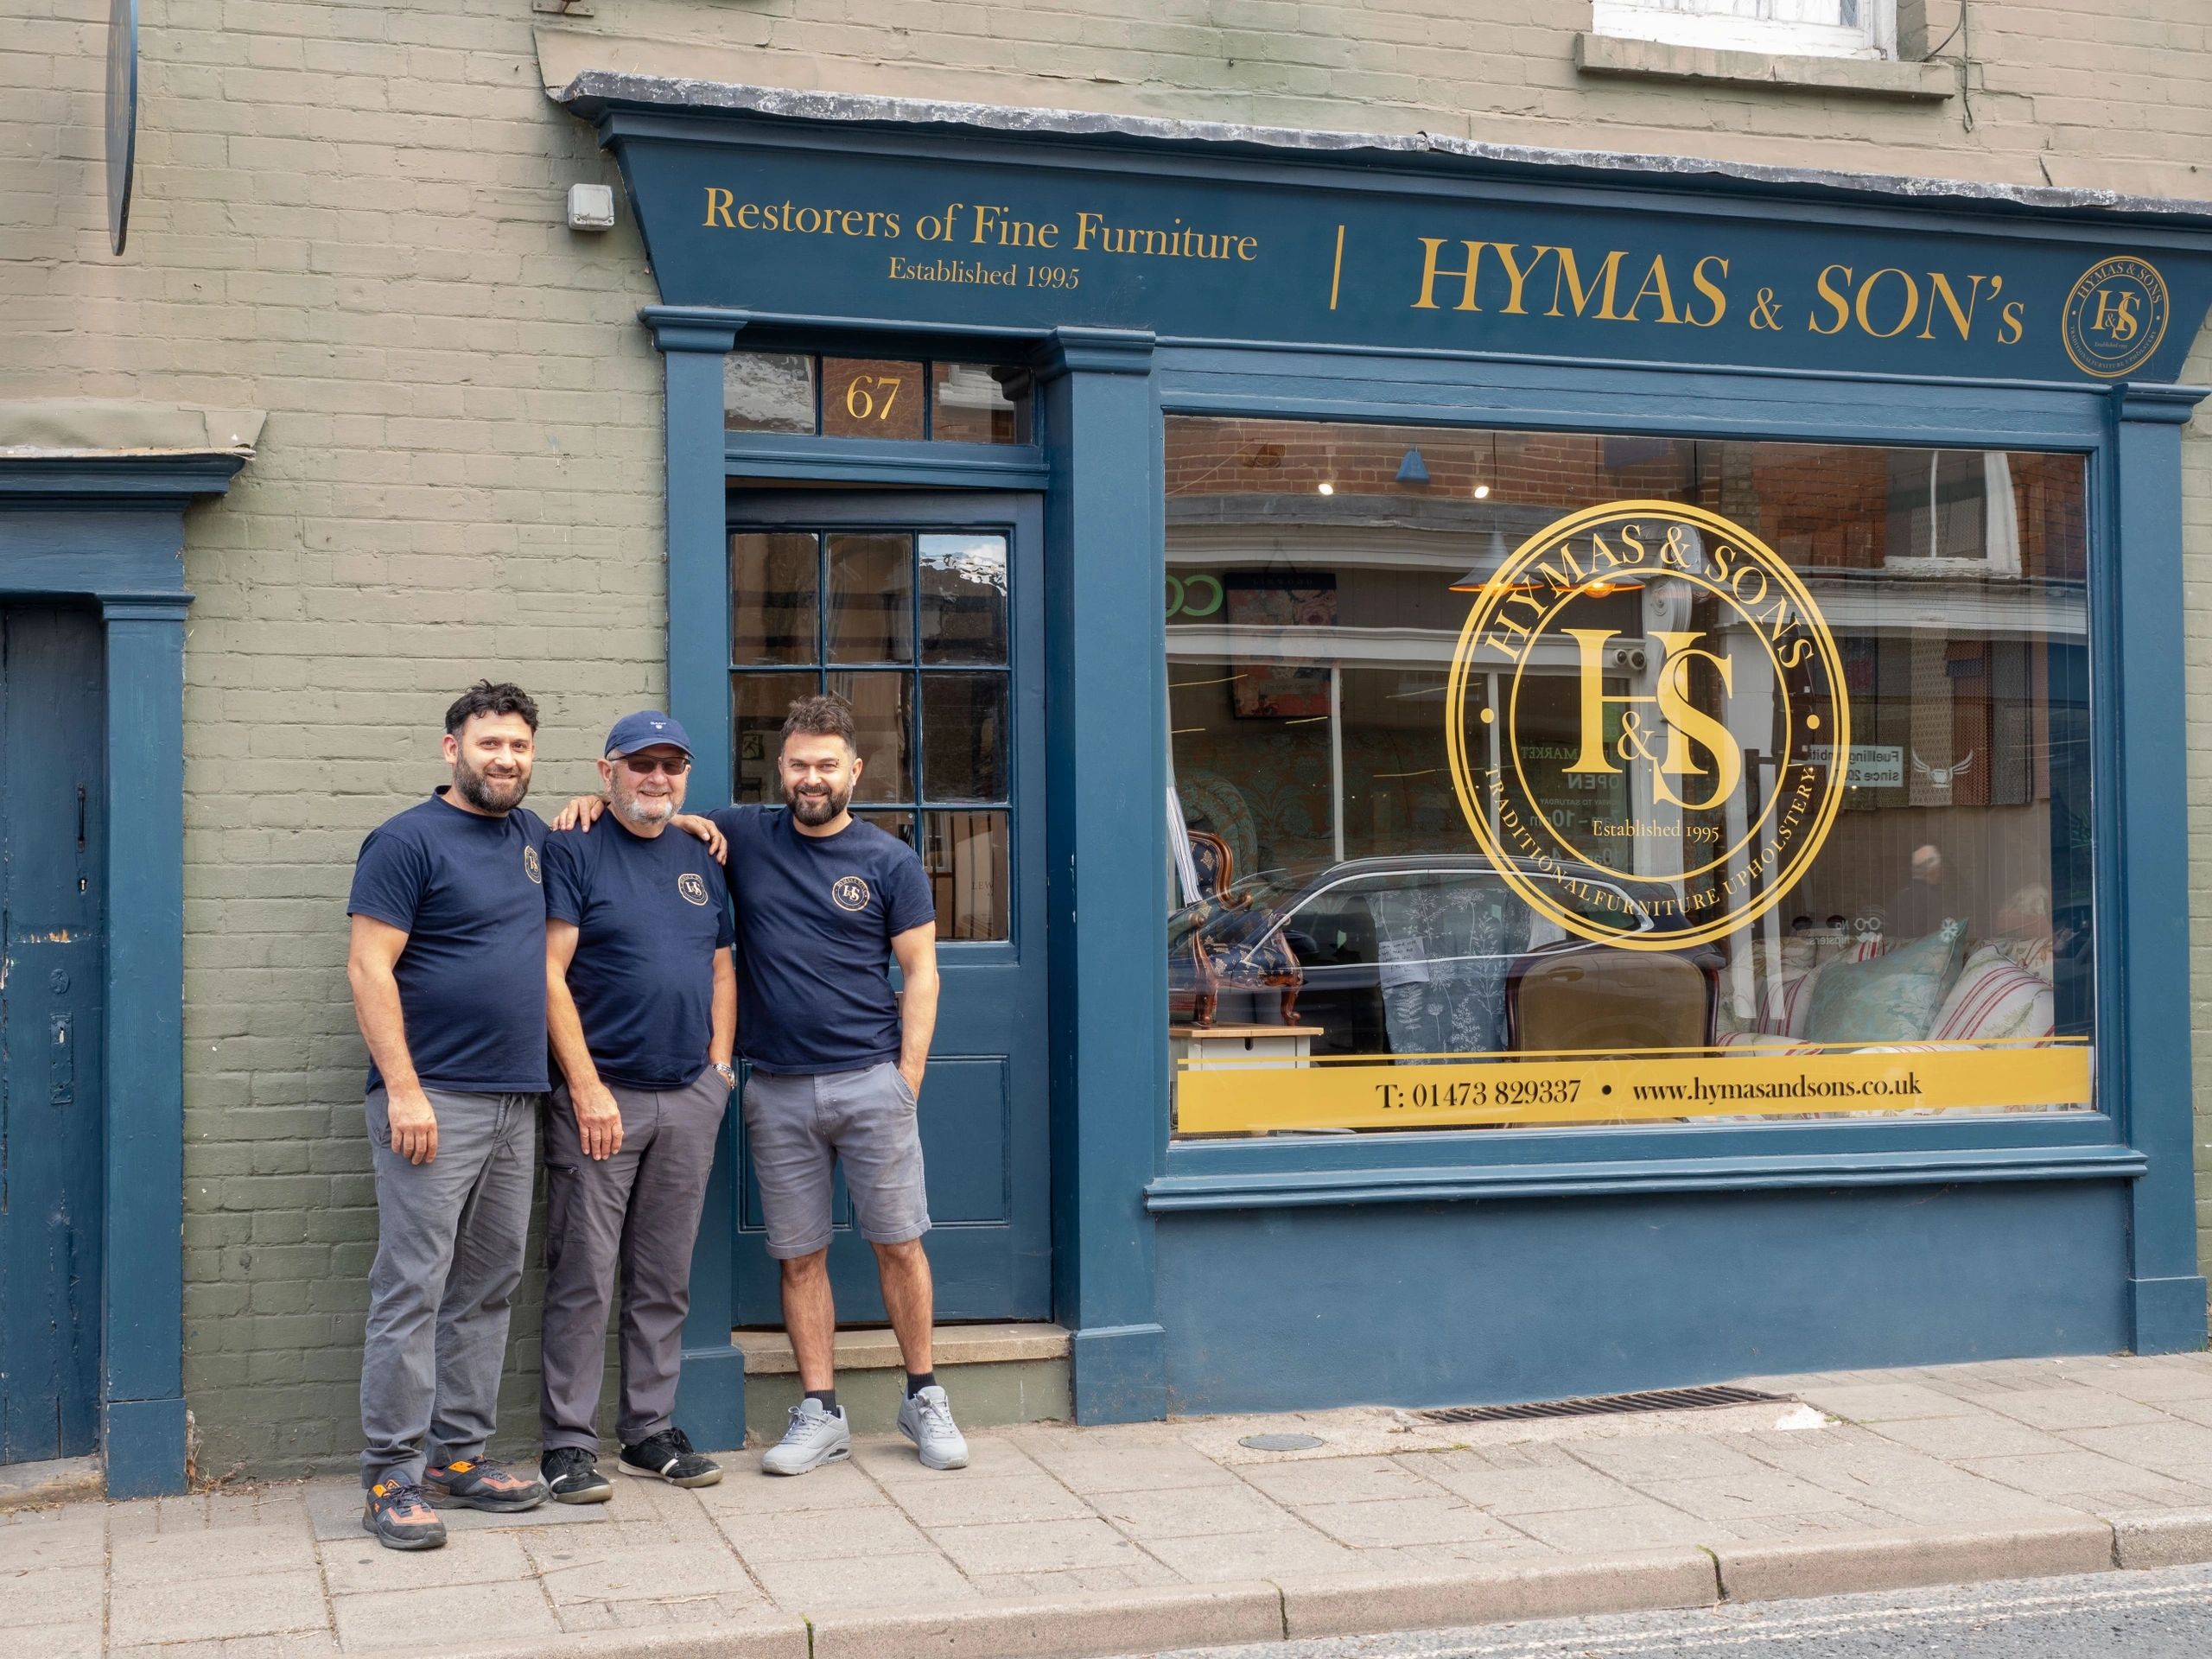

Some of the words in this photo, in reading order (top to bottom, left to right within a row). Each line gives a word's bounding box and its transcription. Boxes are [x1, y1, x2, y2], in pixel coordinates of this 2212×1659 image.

[701, 187, 900, 239] Restorers
[916, 203, 963, 242] of
[970, 206, 1059, 249] Fine
[1072, 213, 1258, 261] Furniture
[888, 257, 1017, 287] Established
[1026, 264, 1079, 289] 1995
[1410, 237, 1729, 328] HYMAS
[1749, 287, 1784, 331] &
[2077, 262, 2124, 300] HYMAS
[2126, 263, 2136, 276] &
[2138, 268, 2163, 303] SONS
[847, 375, 901, 420] 67
[1484, 524, 1646, 664] HYMAS
[1659, 526, 1692, 569] &
[1705, 545, 1815, 669] SONS
[1592, 819, 1681, 837] Established
[1686, 826, 1719, 843] 1995
[1726, 766, 1816, 896] UPHOLSTERY
[1375, 1084, 1404, 1109] T:
[1412, 1082, 1488, 1108] 01473
[1494, 1080, 1581, 1105] 829337
[1632, 1071, 1923, 1105] www.hymasandsons.co.uk
